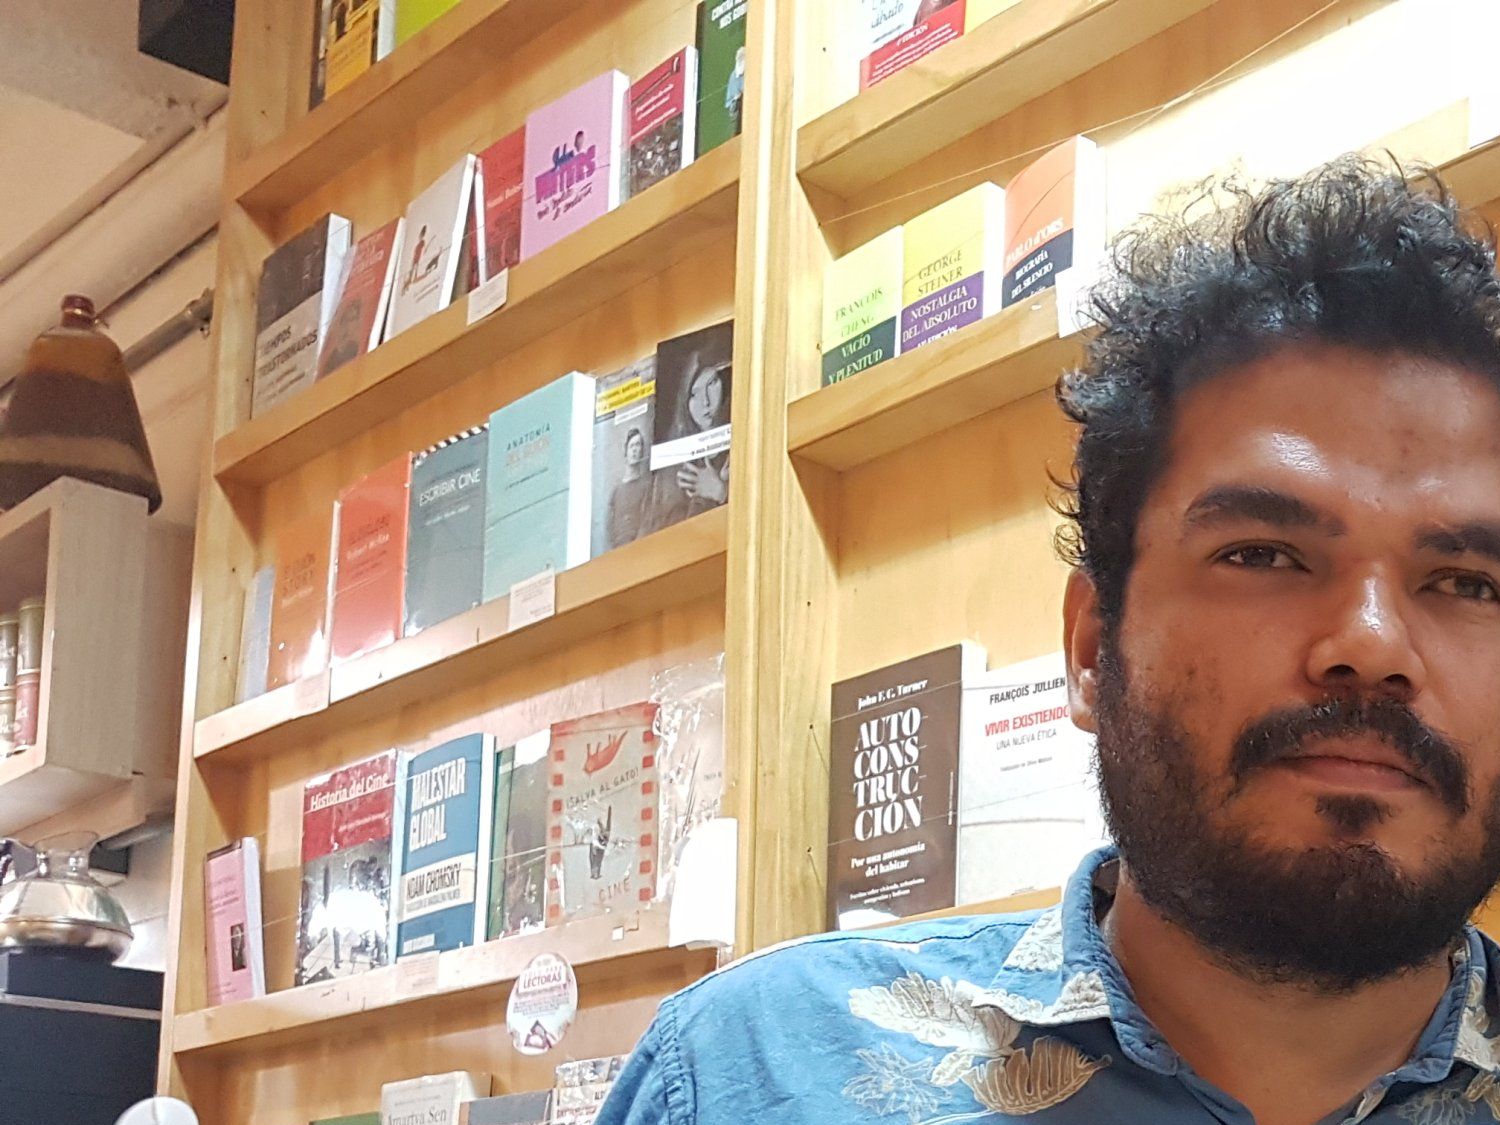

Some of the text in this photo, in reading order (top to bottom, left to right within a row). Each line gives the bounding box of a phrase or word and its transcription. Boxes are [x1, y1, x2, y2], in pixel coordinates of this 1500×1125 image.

[917, 250, 963, 281] GEORGE
[1022, 262, 1054, 295] SILENCIO
[917, 269, 963, 299] STEINER
[910, 285, 968, 322] NOSTALGIA
[902, 297, 978, 344] DEL ABSOLUTO
[837, 348, 884, 382] PLENITUD
[420, 473, 457, 508] ESCRIBIR
[457, 467, 482, 492] CINE
[857, 679, 928, 711] John Turner
[989, 677, 1066, 706] FRANÇOIS JULLIEN
[984, 717, 1011, 738] VIVIR
[996, 732, 1035, 751] UNA NUEVA
[309, 772, 389, 812] Historia del Cine
[411, 756, 466, 814] MALESTAR
[409, 804, 448, 853] GLOBAL
[598, 876, 632, 902] CINE
[522, 972, 563, 990] LECTORAS
[426, 1104, 448, 1124] Sen
